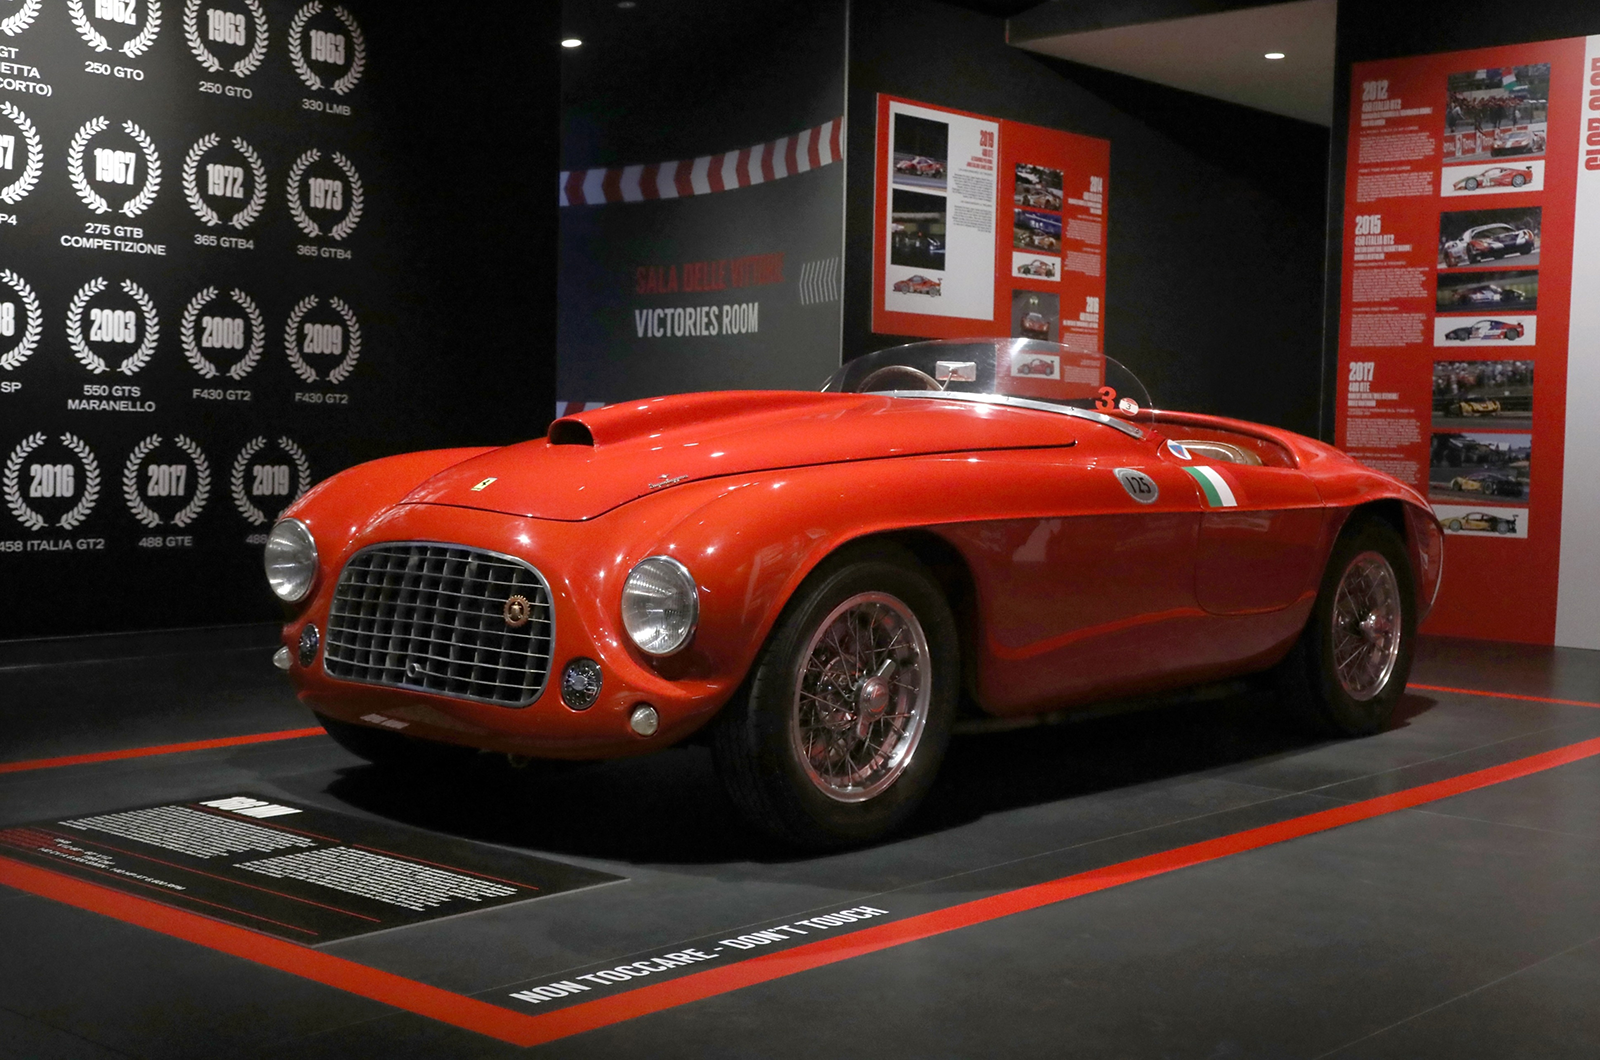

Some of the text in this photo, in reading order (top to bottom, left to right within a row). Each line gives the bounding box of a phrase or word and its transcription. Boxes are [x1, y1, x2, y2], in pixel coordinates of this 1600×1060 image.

[94, 0, 137, 26] 1962
[207, 9, 246, 46] 1963
[0, 45, 19, 59] GT
[309, 29, 345, 65] 1963
[0, 62, 41, 79] ETTA
[85, 61, 145, 81] 250 GTO
[198, 81, 253, 100] 250 GTO
[1362, 80, 1388, 101] 2012
[301, 98, 351, 116] 330 LMB
[93, 148, 136, 186] 1967
[206, 164, 244, 199] 1972
[308, 177, 343, 211] 1973
[0, 213, 18, 226] P4
[1355, 215, 1381, 235] 2015
[85, 222, 144, 239] 275 GTB
[60, 234, 167, 257] COMPETIZIONE
[193, 234, 254, 250] 365 GTB4
[296, 244, 352, 260] 365 GTB4
[636, 265, 679, 294] SALA
[683, 260, 727, 292] DELLE
[0, 301, 15, 337] 8
[89, 308, 136, 344] 2003
[634, 302, 759, 338] VICTORIES ROOM
[201, 316, 244, 350] 2008
[303, 323, 343, 355] 2009
[1349, 361, 1375, 381] 2017
[0, 381, 22, 394] SP
[83, 384, 141, 398] 550 GTS
[192, 388, 251, 401] F430 GT2
[67, 398, 156, 412] MARANELLO
[294, 392, 349, 404] F430 GT2
[1095, 386, 1117, 413] 3
[29, 464, 75, 497] 2016
[147, 464, 187, 497] 2017
[252, 465, 290, 496] 2019
[1125, 476, 1152, 494] 125
[0, 538, 106, 552] 458 ITALIA GT2
[138, 536, 193, 548] 488 GTE
[509, 978, 593, 1004] NON
[575, 946, 720, 987] TOCCARE
[718, 924, 810, 951] DON'T
[795, 905, 890, 932] TOUCH
